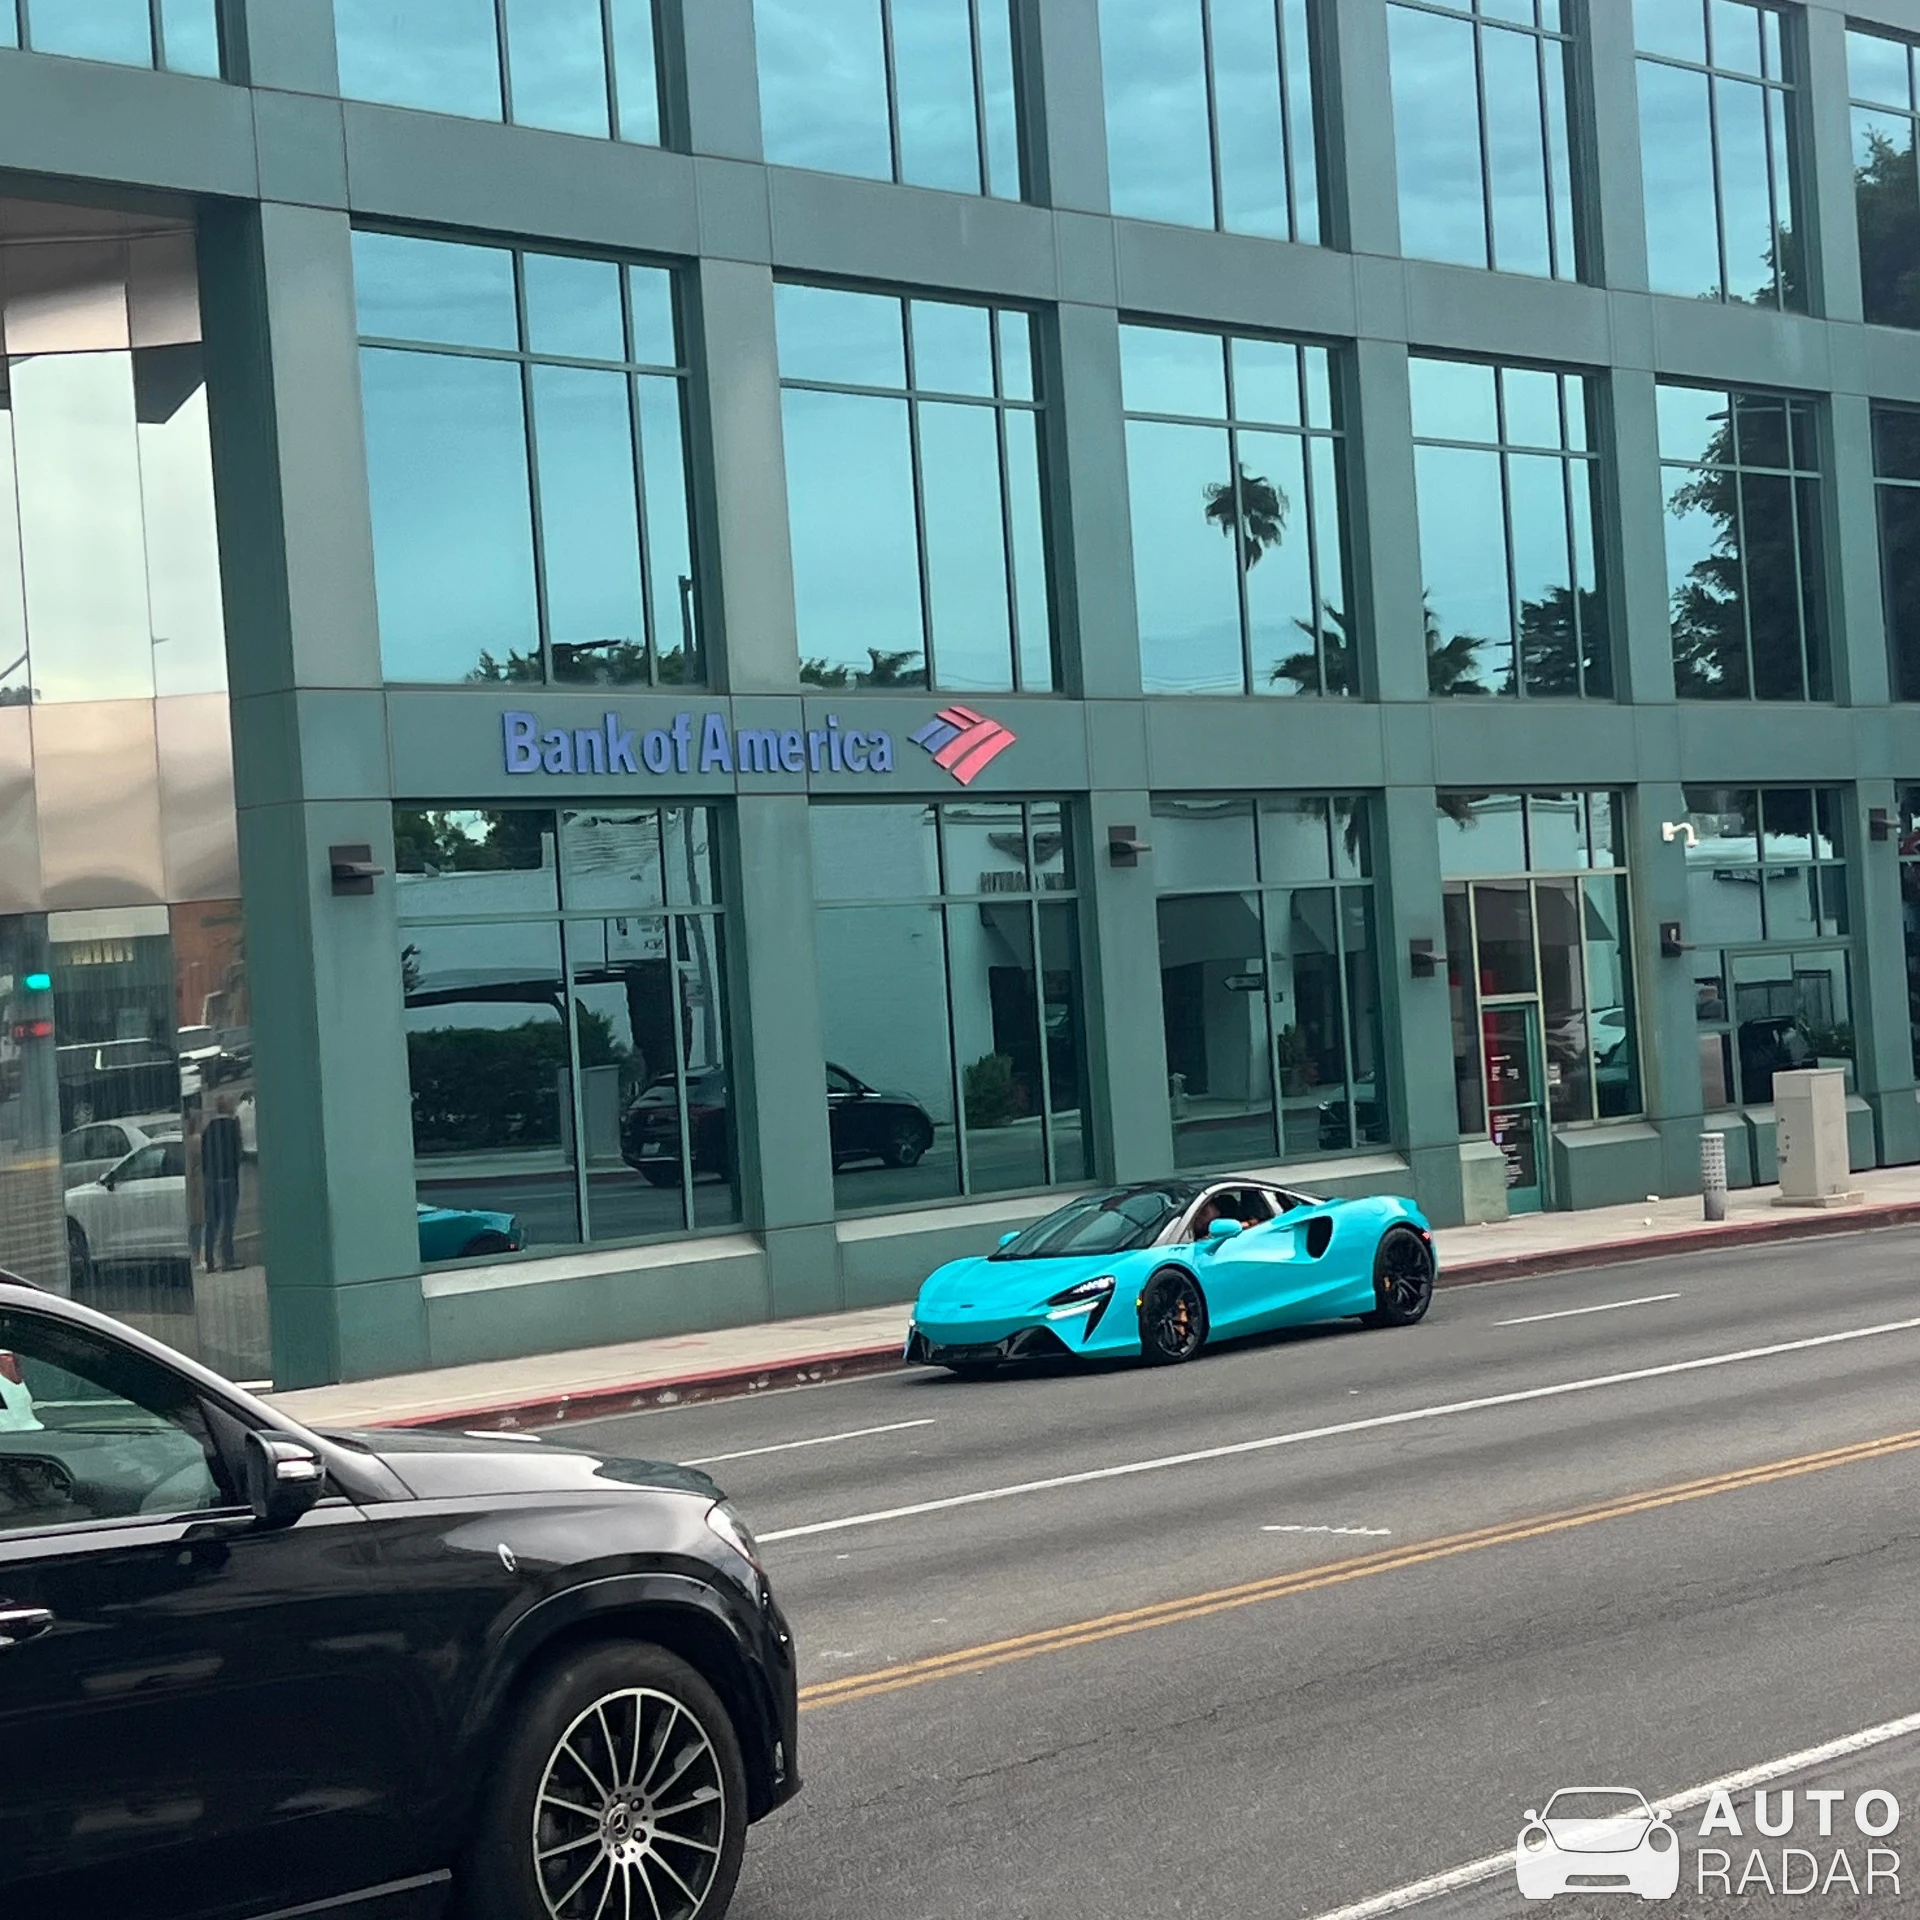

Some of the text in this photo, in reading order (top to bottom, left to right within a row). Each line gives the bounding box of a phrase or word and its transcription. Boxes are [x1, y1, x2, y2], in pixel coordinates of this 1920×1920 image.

[501, 710, 894, 773] Bank of America
